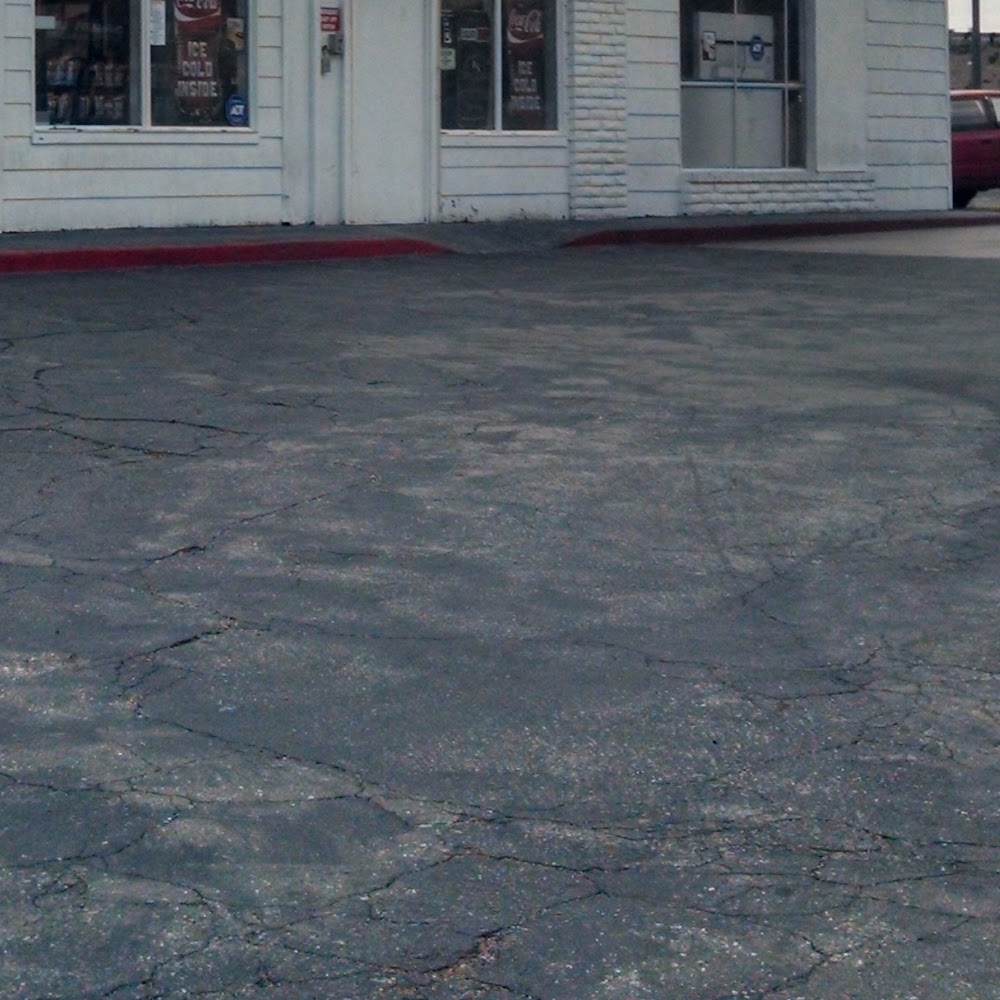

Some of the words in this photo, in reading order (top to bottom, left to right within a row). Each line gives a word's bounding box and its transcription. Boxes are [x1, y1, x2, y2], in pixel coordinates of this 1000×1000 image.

[187, 41, 208, 57] ICE
[182, 60, 214, 77] COLD
[175, 80, 218, 97] INSIDE
